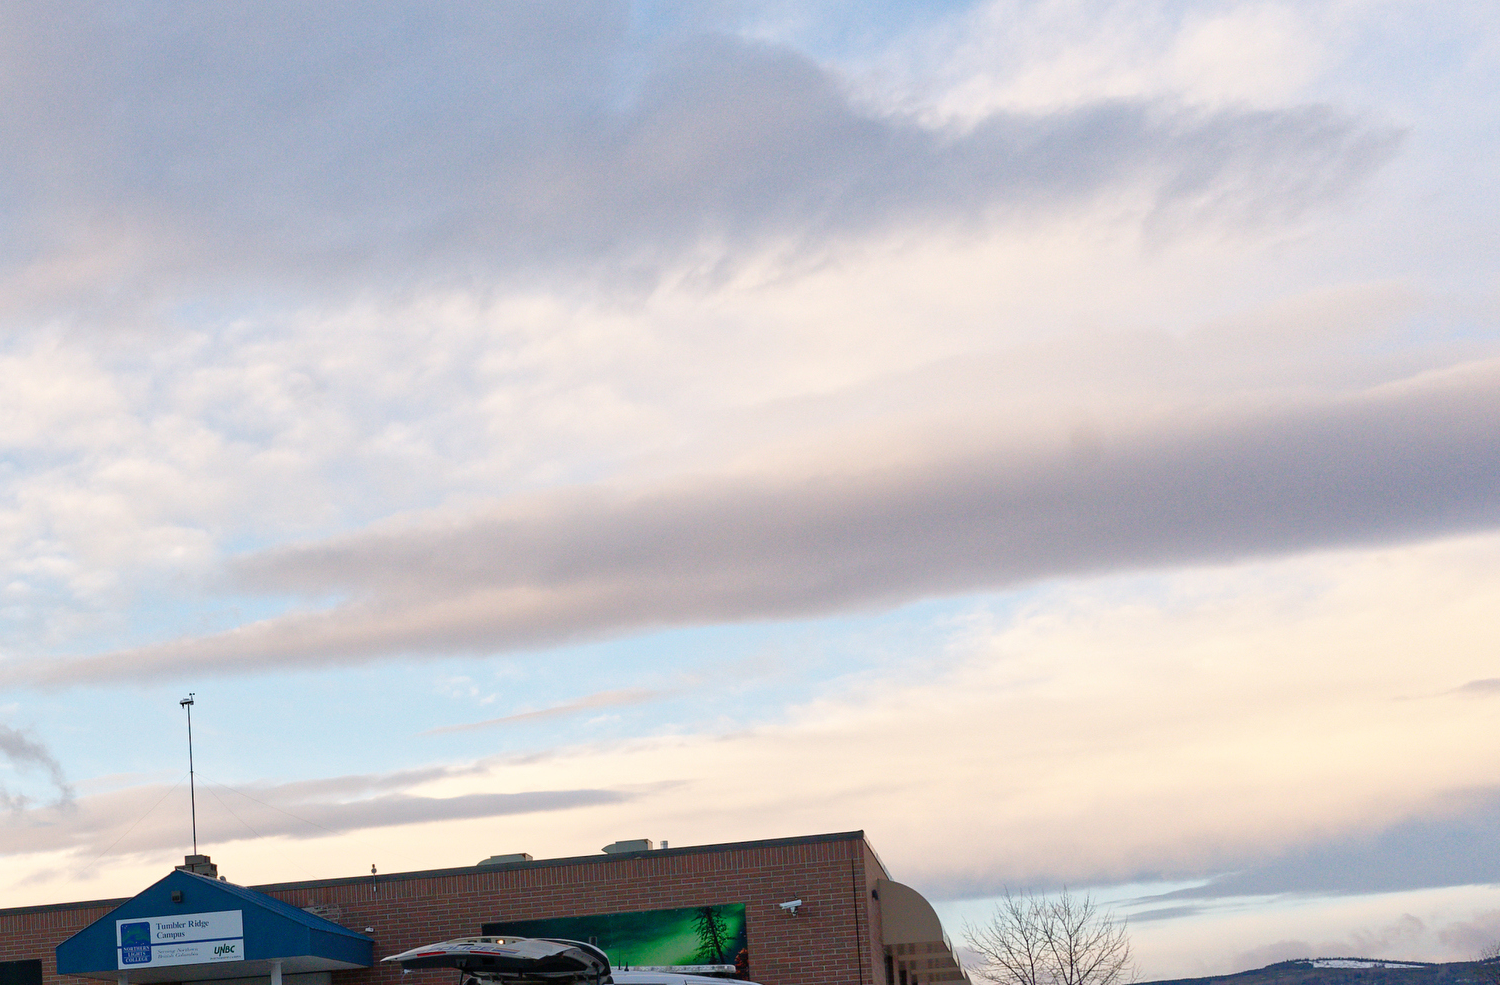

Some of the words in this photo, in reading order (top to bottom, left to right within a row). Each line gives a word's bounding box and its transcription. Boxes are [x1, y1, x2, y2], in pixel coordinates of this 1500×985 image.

[156, 921, 186, 930] Tumbler
[188, 920, 209, 928] Ridge
[156, 931, 185, 939] Campus
[214, 943, 236, 957] UNBC
